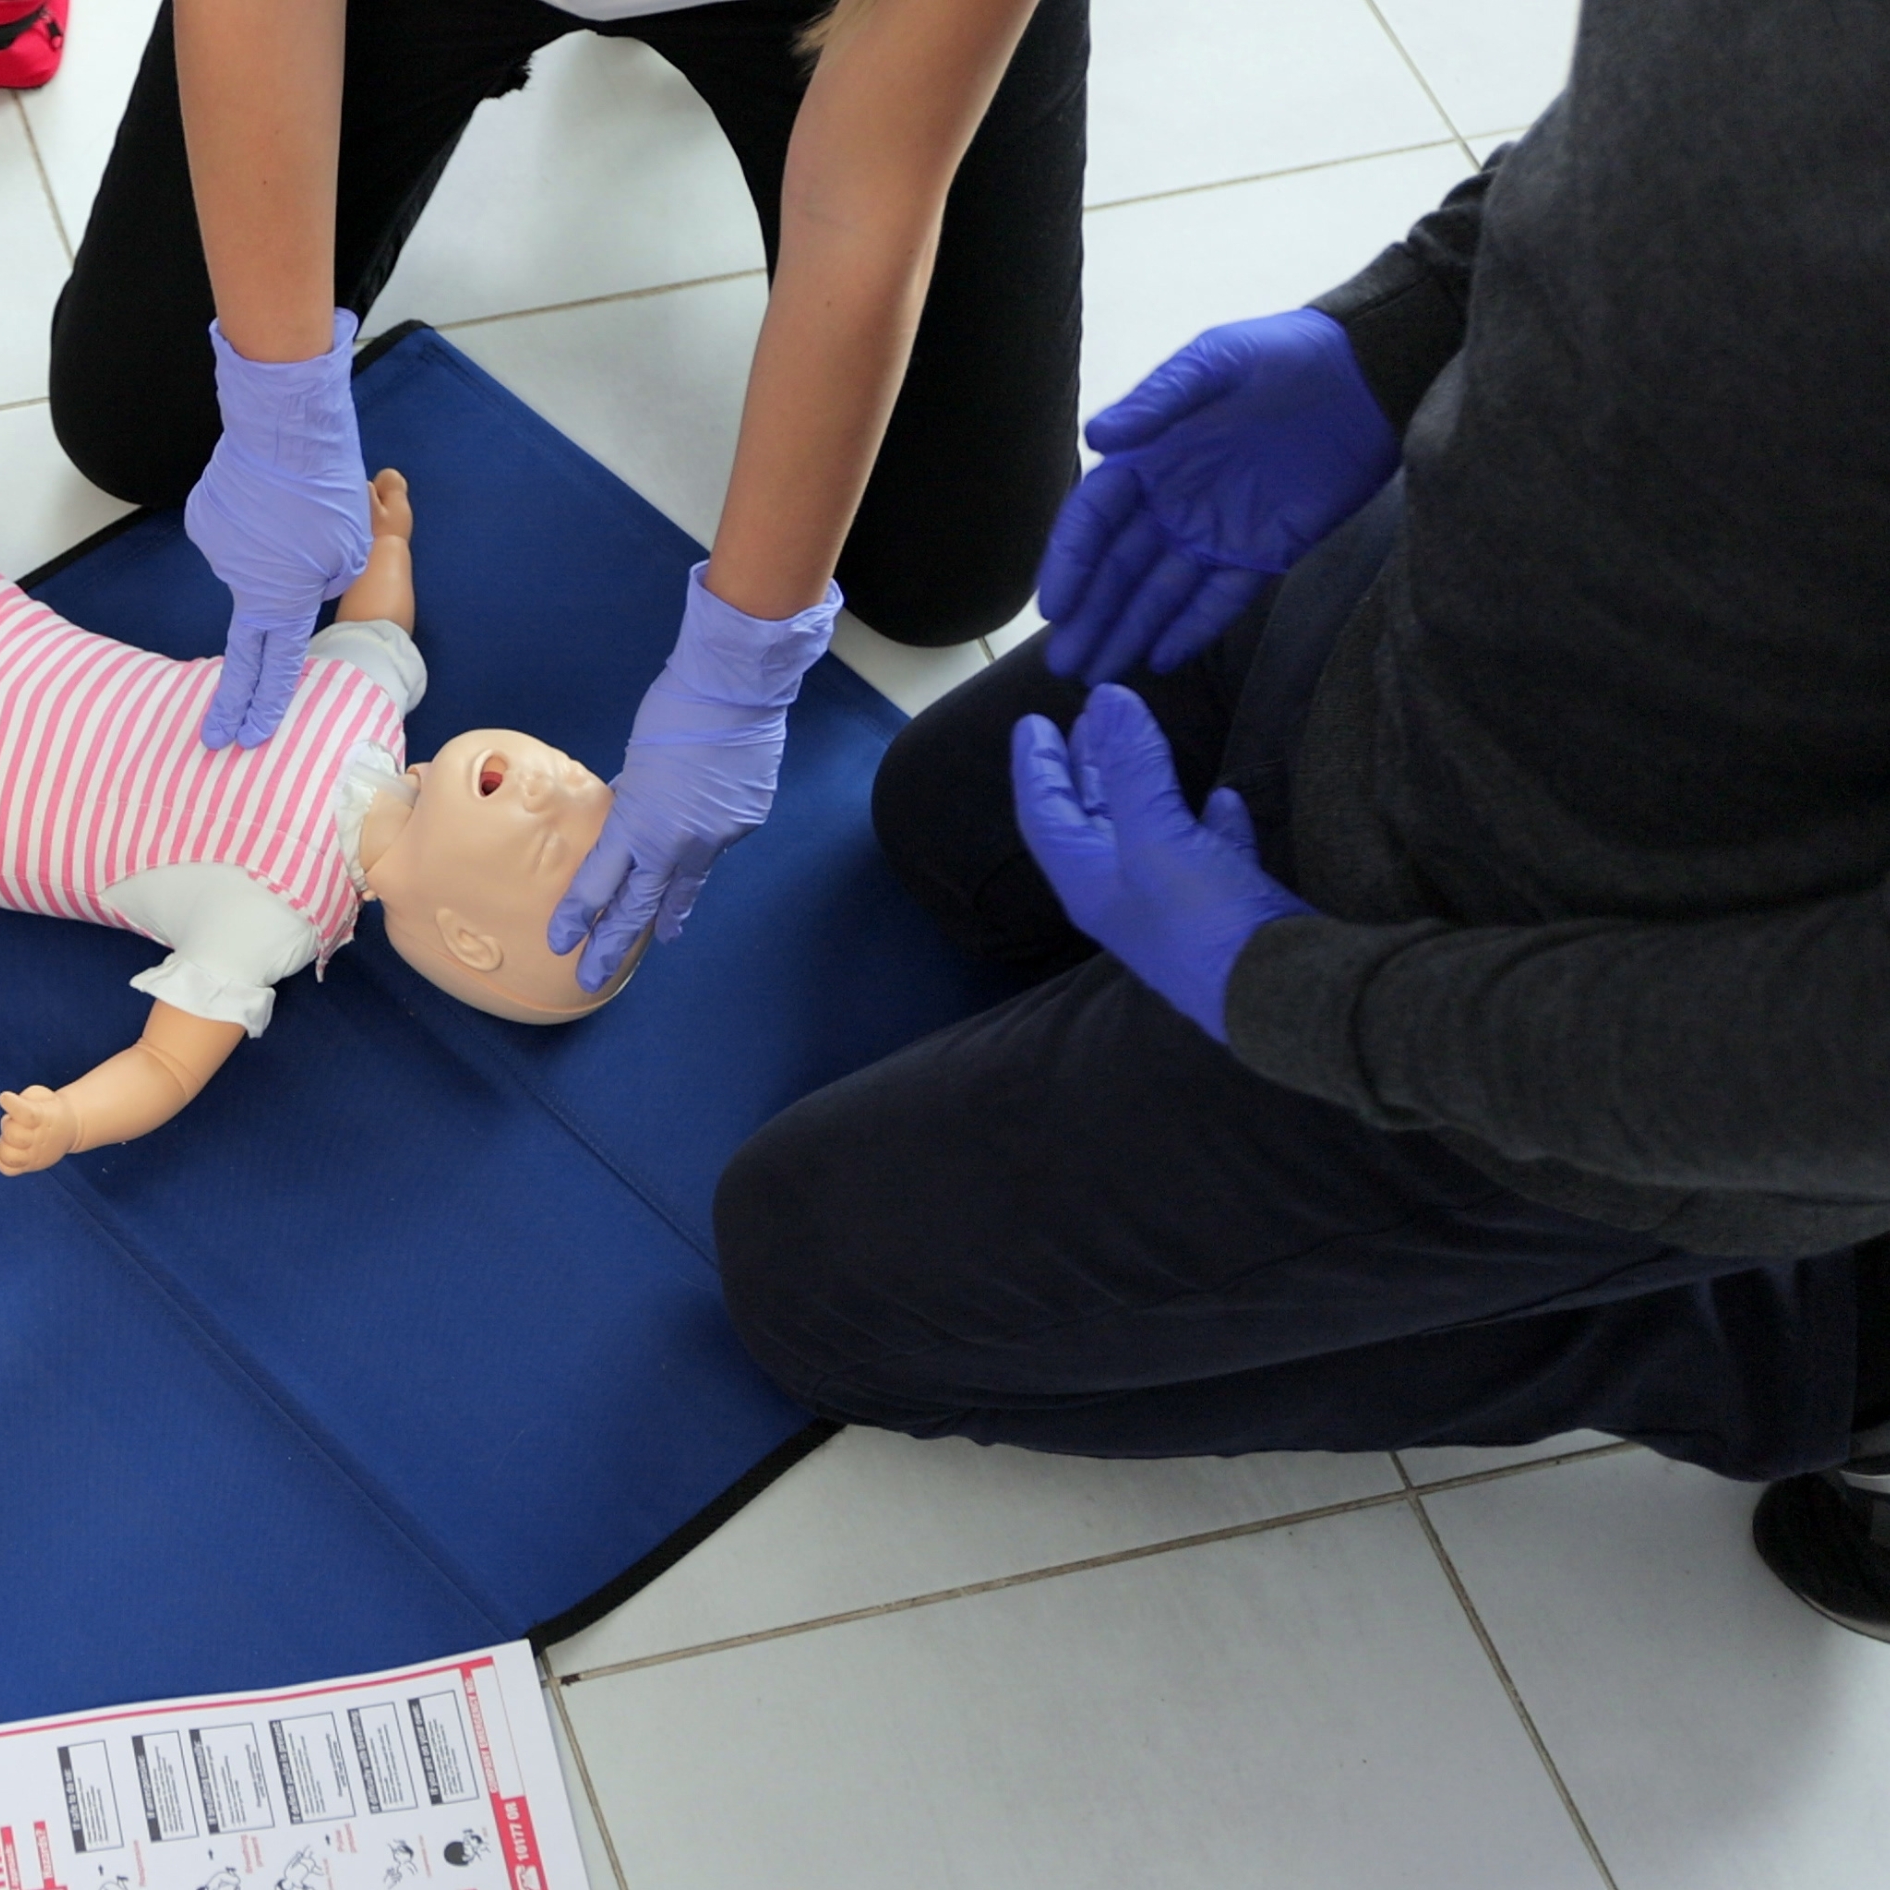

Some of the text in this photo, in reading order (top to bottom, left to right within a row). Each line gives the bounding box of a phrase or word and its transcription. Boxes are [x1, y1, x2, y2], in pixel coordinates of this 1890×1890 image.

[467, 1694, 488, 1749] EMERGENCY
[416, 1725, 427, 1744] your
[279, 1753, 287, 1761] is
[358, 1750, 369, 1767] with
[420, 1744, 429, 1756] on
[424, 1756, 433, 1770] are
[481, 1749, 498, 1793] COMPANY
[281, 1761, 293, 1784] pulse
[427, 1771, 438, 1786] you
[65, 1782, 74, 1793] do
[430, 1787, 439, 1795] If
[67, 1794, 76, 1803] to
[200, 1778, 215, 1816] breathing
[69, 1803, 79, 1822] safe
[72, 1822, 81, 1830] If
[504, 1801, 529, 1861] 10177 OR
[36, 1829, 54, 1878] Hazards?
